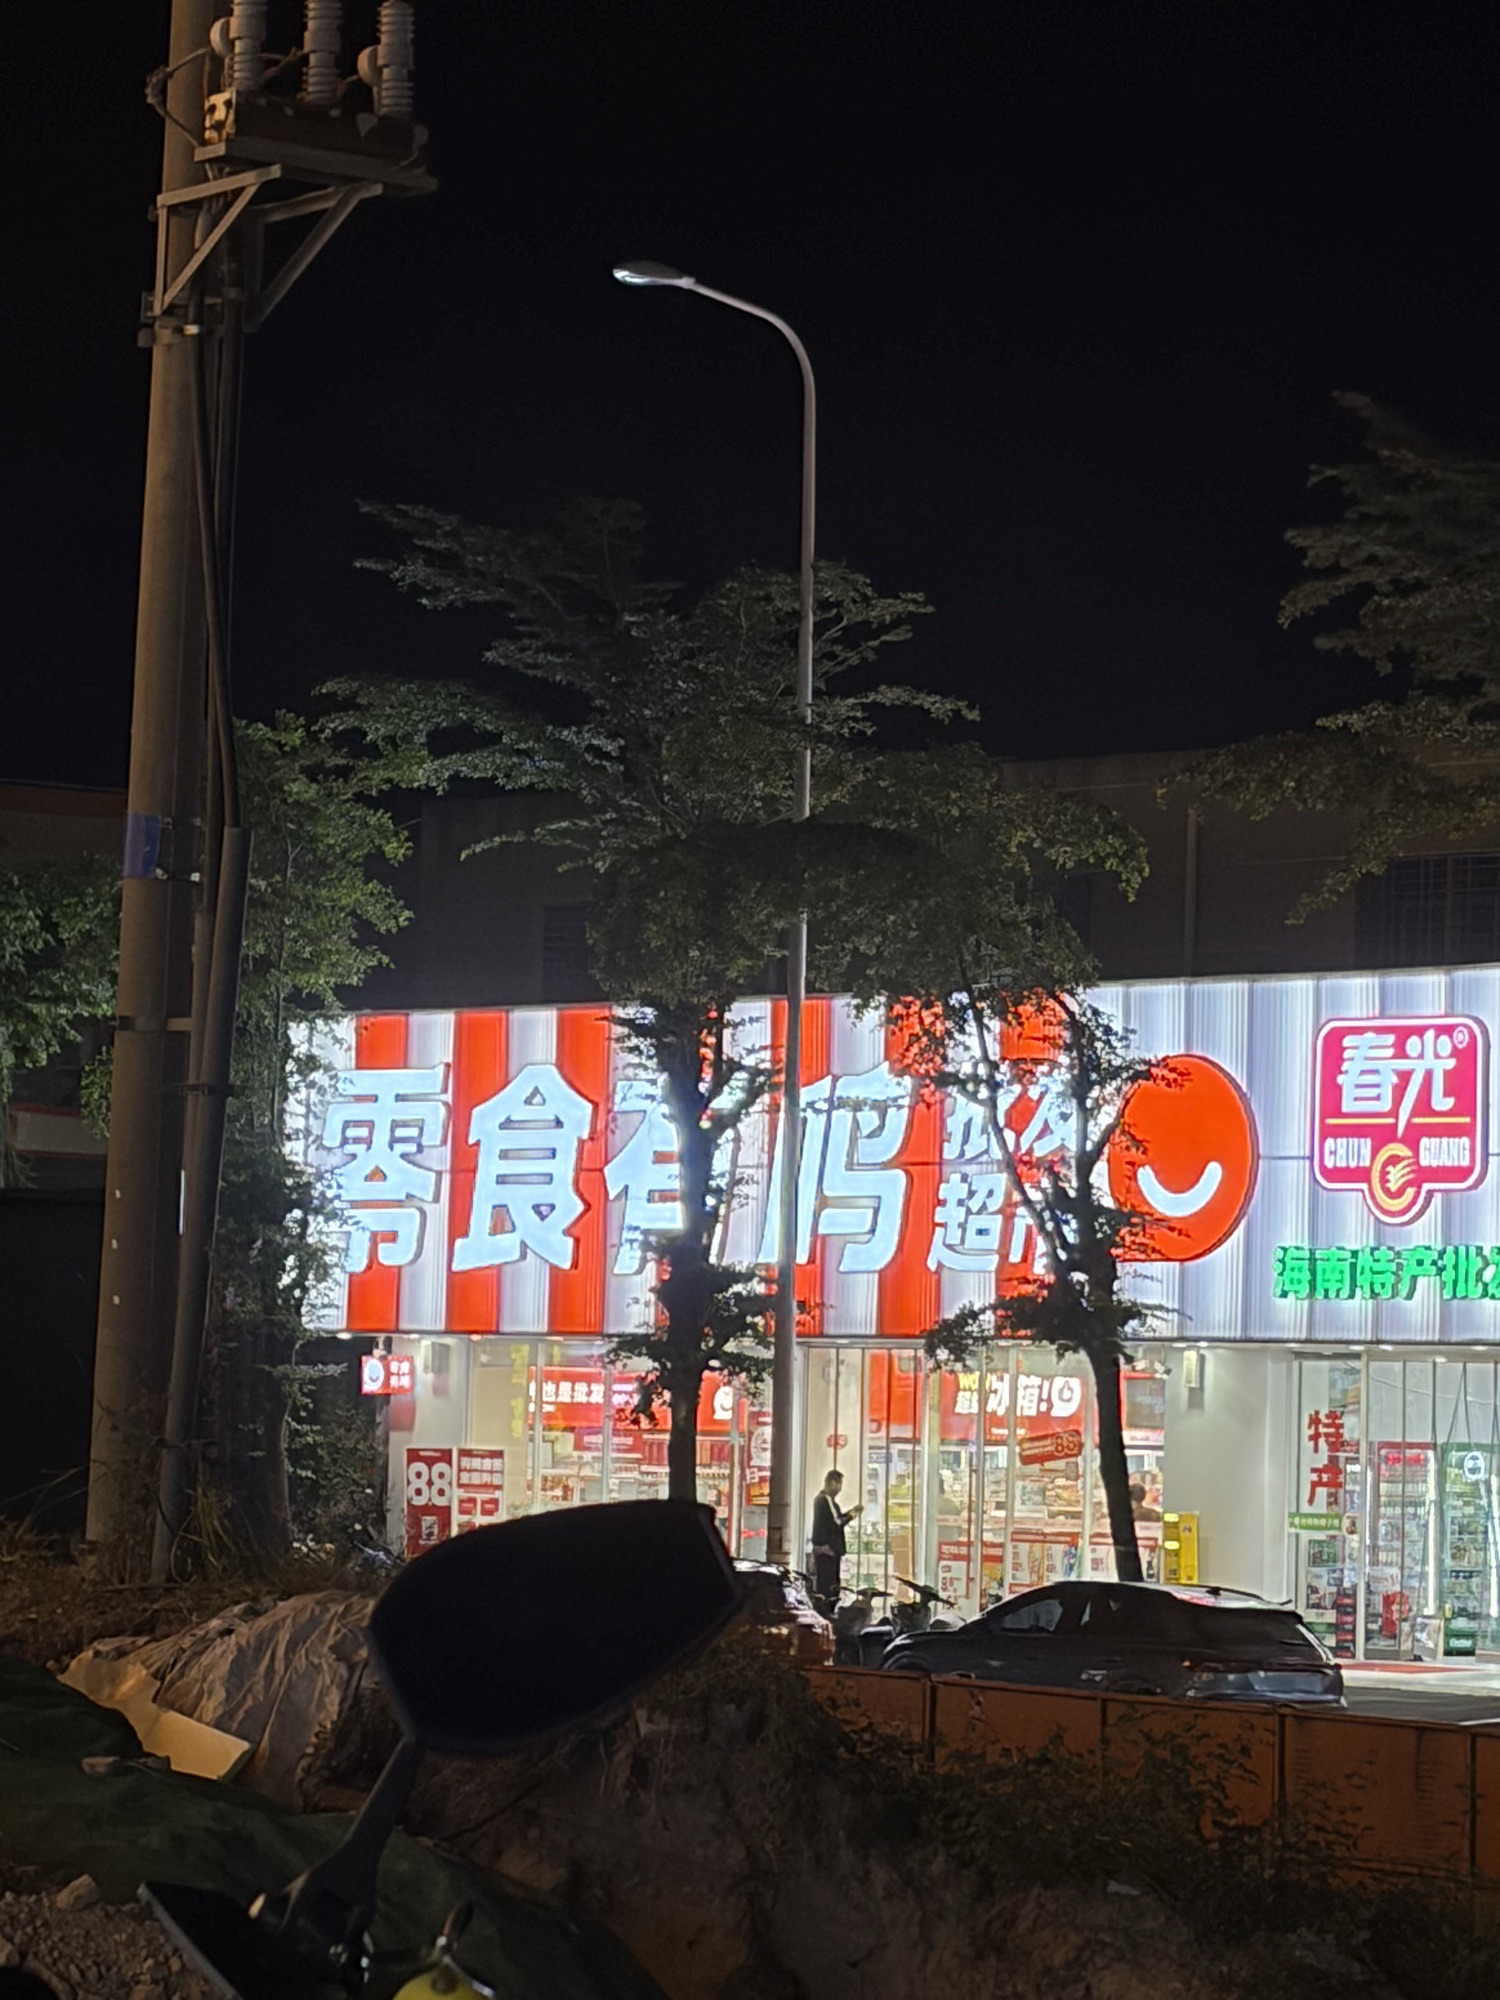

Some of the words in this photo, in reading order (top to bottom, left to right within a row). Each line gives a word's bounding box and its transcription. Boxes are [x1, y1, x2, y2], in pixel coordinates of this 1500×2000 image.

[1336, 1029, 1457, 1139] 春光
[1323, 1137, 1372, 1169] CHUN
[1419, 1136, 1470, 1167] GUANG
[1307, 1409, 1344, 1506] 特产
